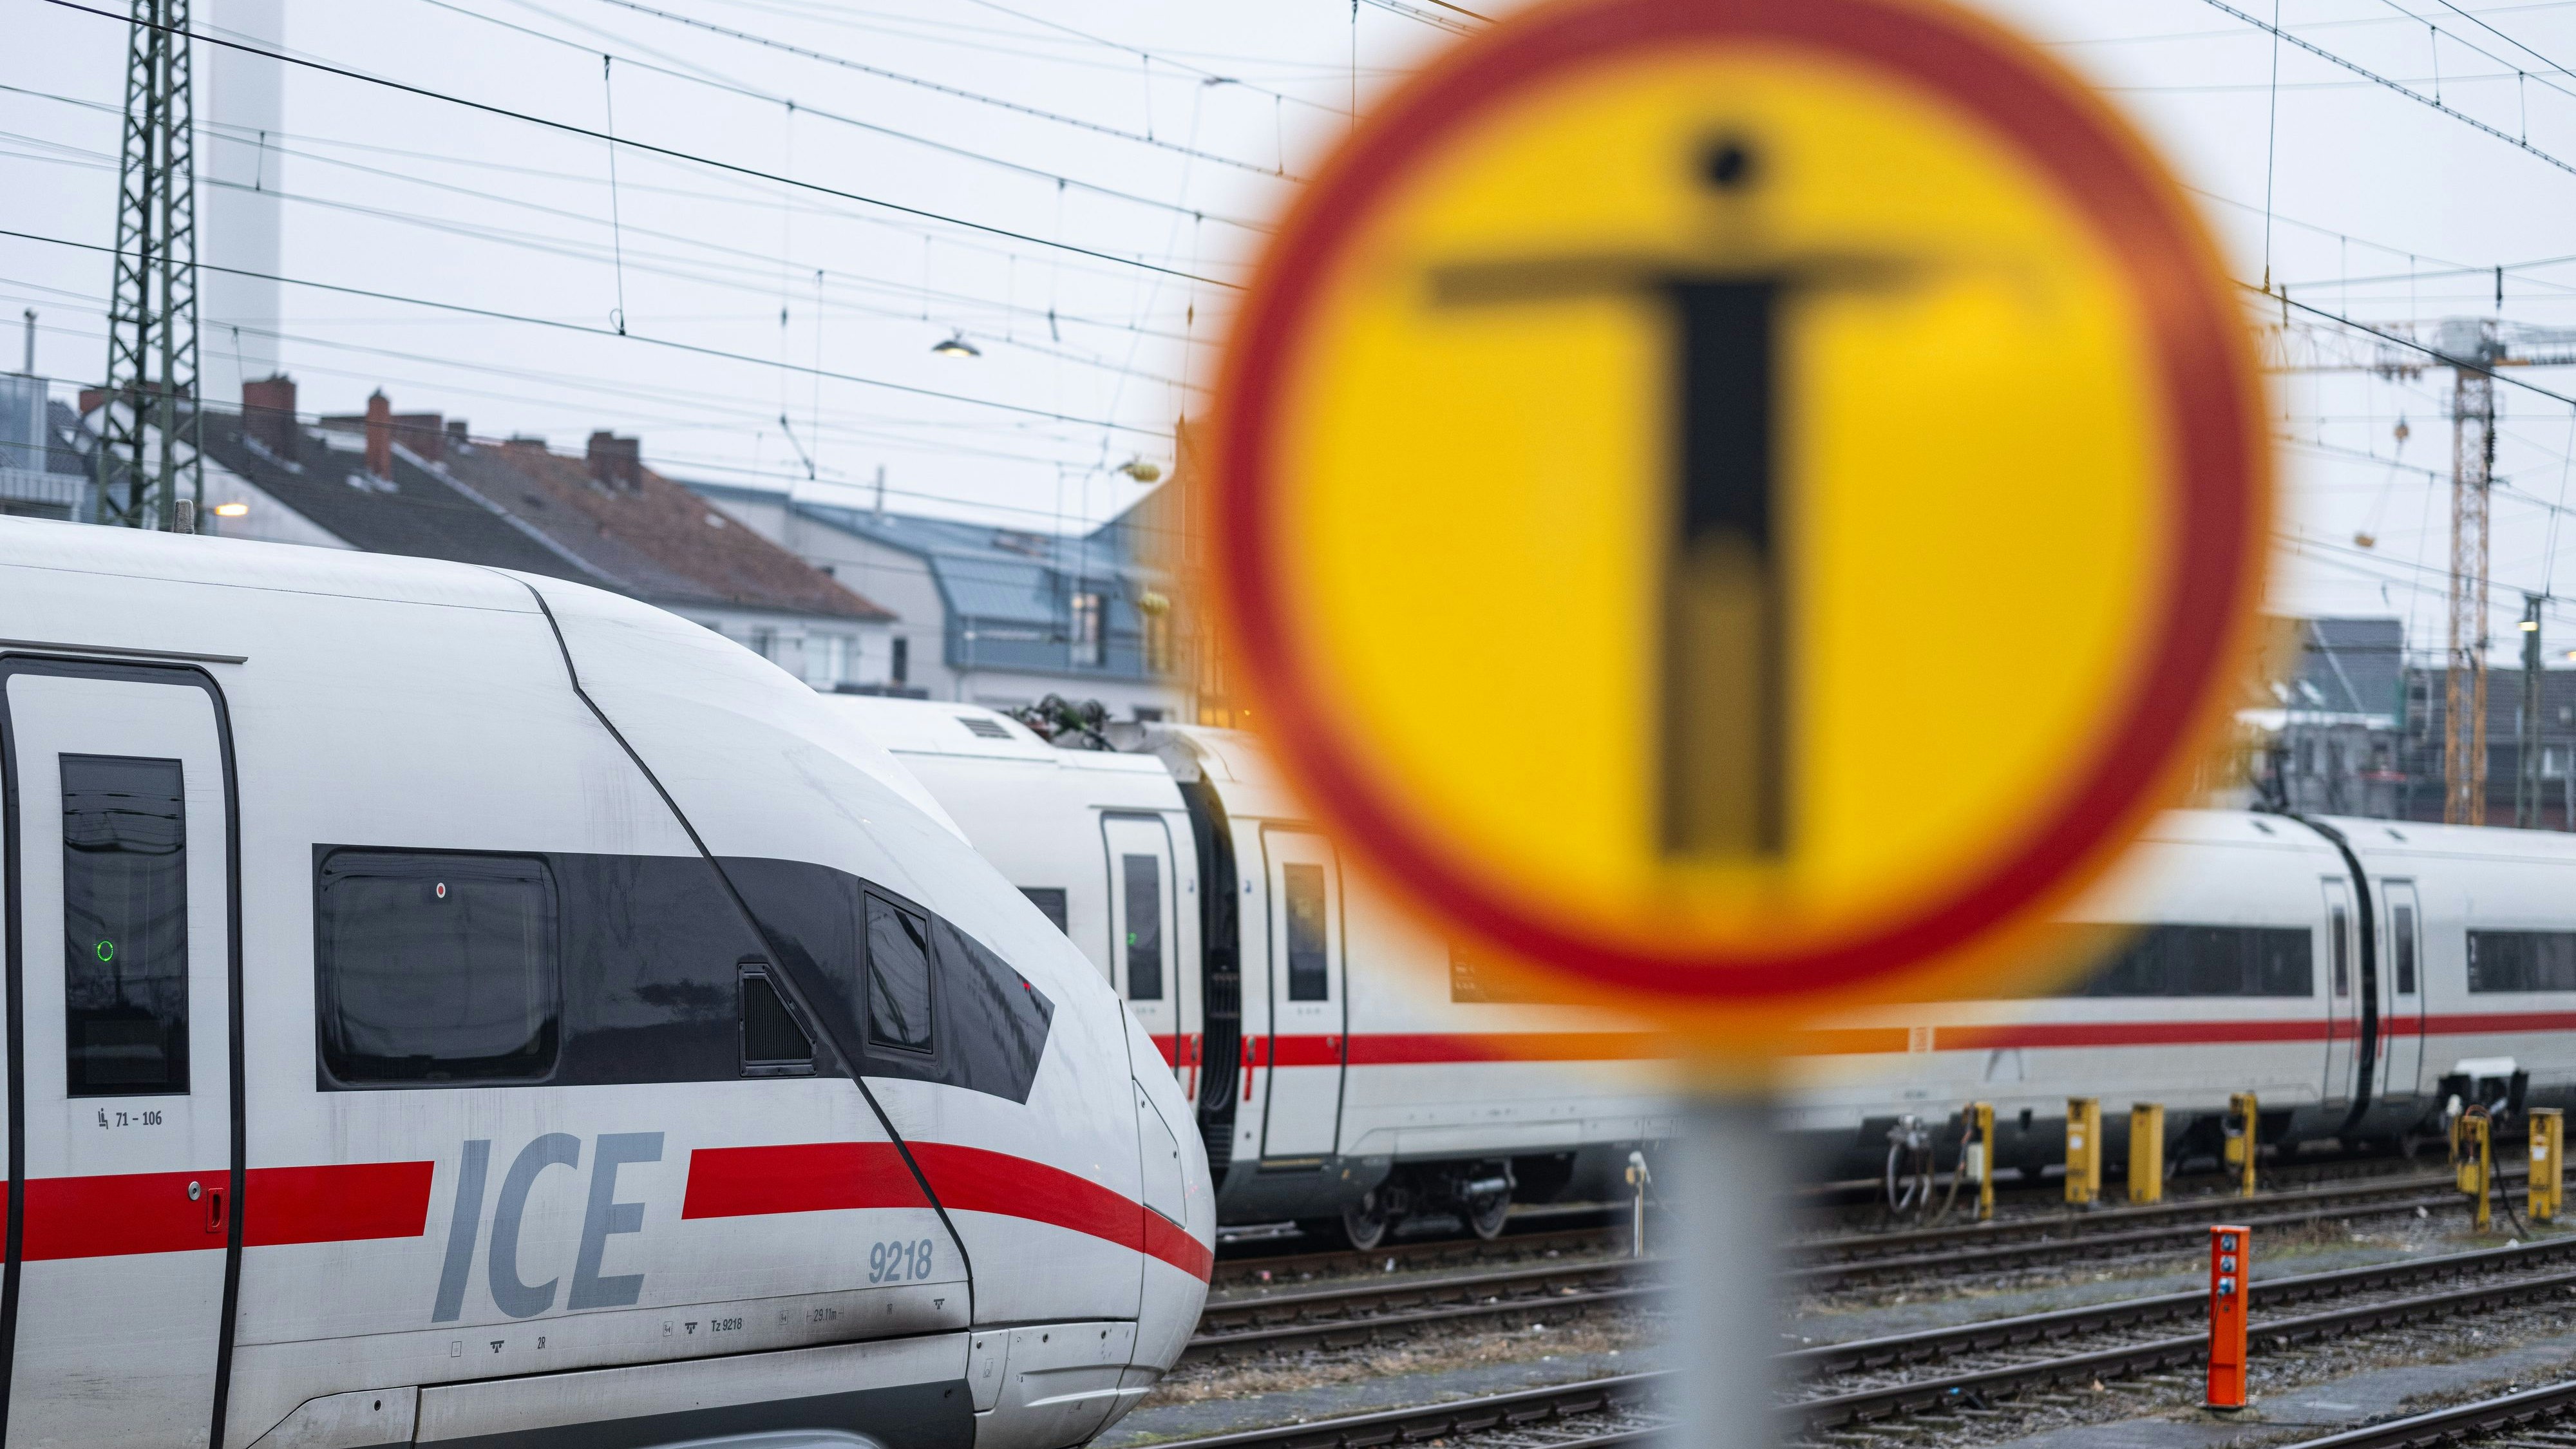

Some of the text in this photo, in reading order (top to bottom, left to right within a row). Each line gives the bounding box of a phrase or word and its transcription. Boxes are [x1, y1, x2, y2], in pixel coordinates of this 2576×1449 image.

[116, 1112, 128, 1127] 71
[143, 1111, 162, 1125] 106
[431, 1132, 665, 1323] ICE
[869, 1238, 933, 1283] 9218
[813, 1308, 837, 1321] 29.11m
[711, 1318, 742, 1331] Tz 9218
[537, 1336, 546, 1349] 2R
